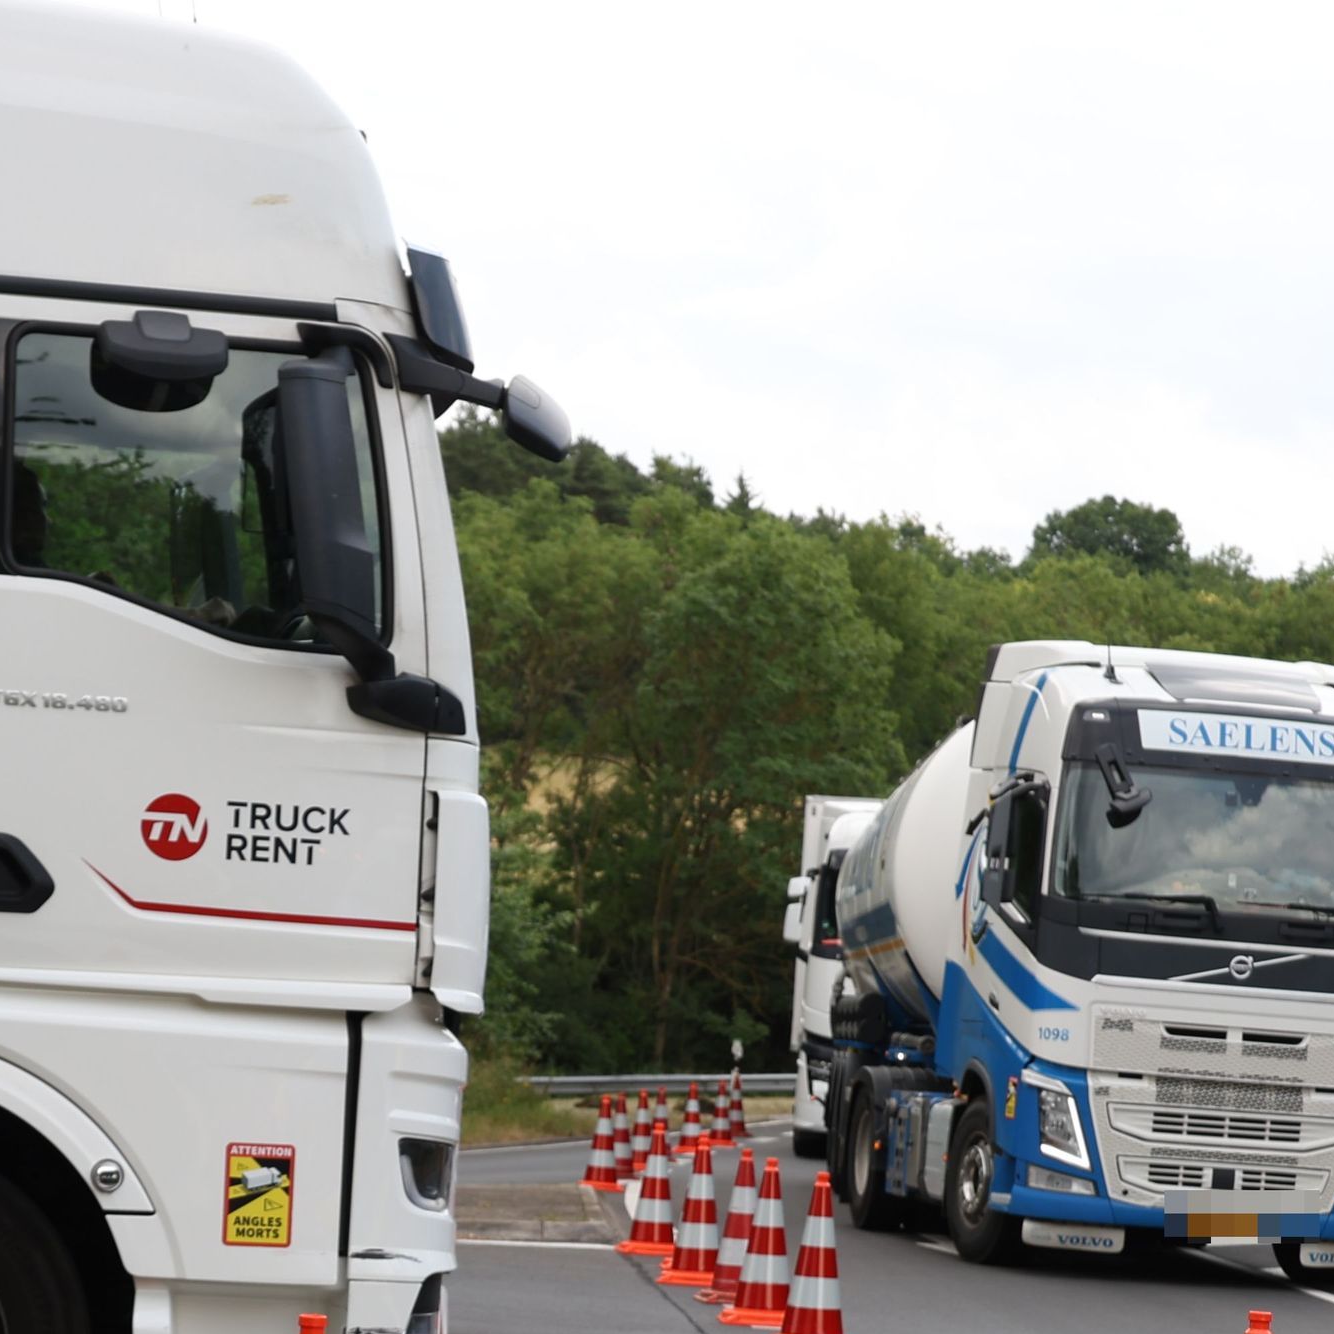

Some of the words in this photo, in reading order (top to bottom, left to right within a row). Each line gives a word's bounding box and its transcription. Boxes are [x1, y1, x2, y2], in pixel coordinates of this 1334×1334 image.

[42, 693, 128, 713] 18.480
[227, 801, 350, 835] TRUCK
[226, 833, 321, 865] RENT
[1038, 1027, 1070, 1041] 1098
[230, 1145, 292, 1157] ATTENTION
[233, 1216, 283, 1227] ANGLES
[235, 1228, 280, 1239] MORTS
[1057, 1235, 1115, 1248] VOLVO
